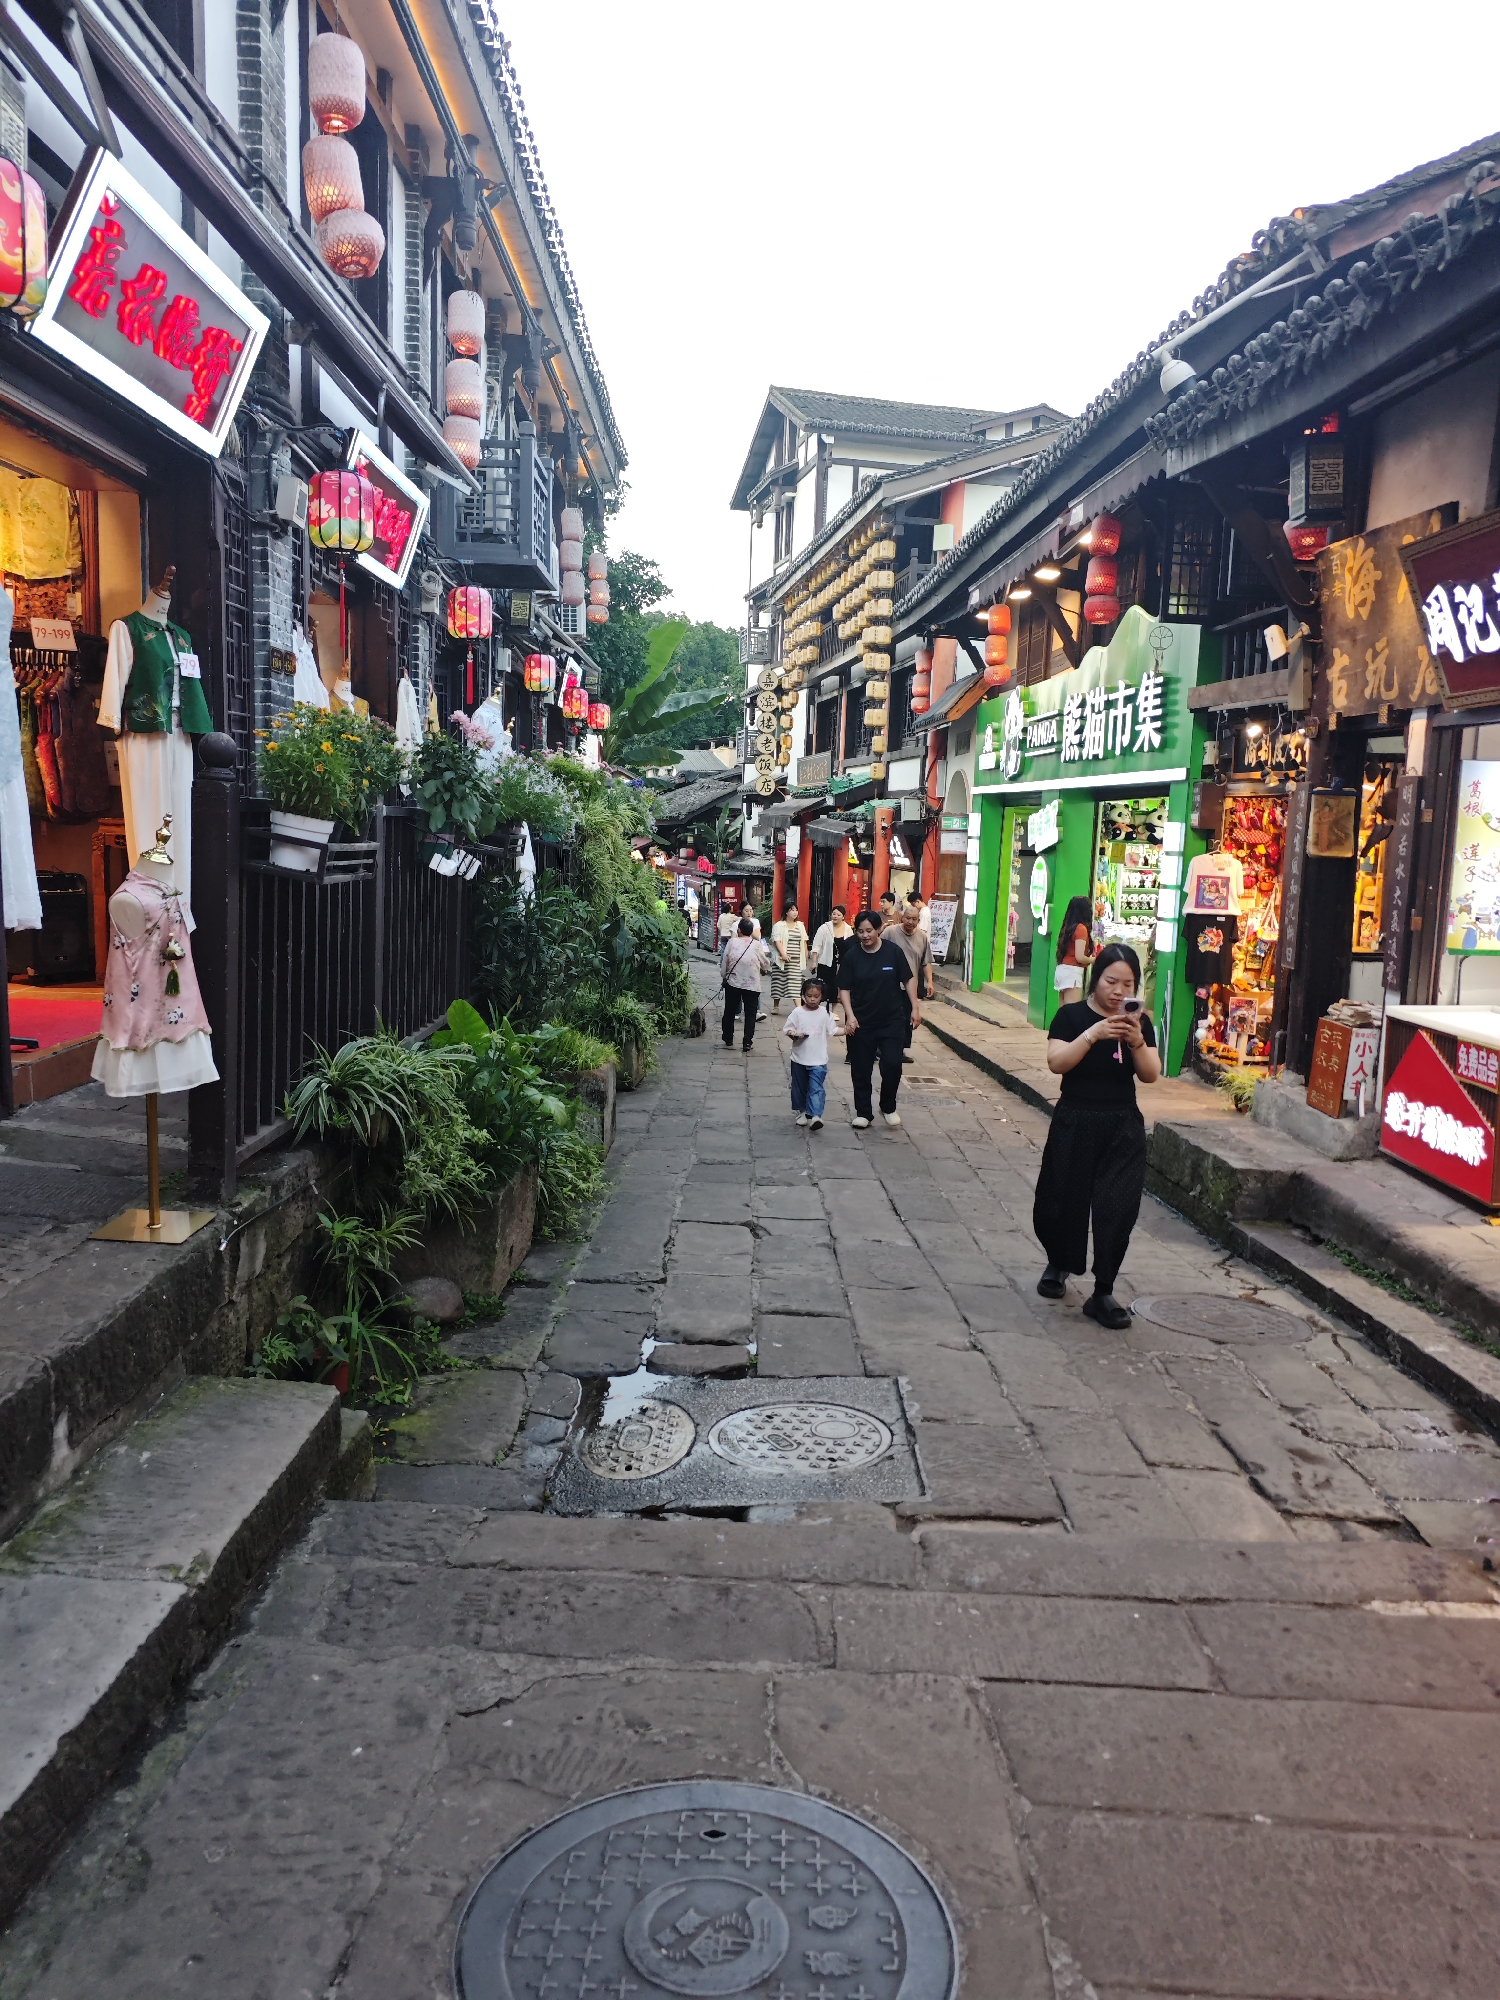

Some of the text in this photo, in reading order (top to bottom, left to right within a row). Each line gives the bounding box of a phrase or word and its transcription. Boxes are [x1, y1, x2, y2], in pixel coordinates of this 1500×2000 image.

[34, 627, 71, 640] 79-199
[1421, 568, 1500, 664] 周记
[182, 657, 197, 671] 79
[759, 672, 776, 794] 嘉滨楼老饭店
[1027, 717, 1058, 749] PANDA
[1060, 671, 1163, 764] 熊猫市集
[1463, 779, 1482, 818] 葛根
[1458, 1043, 1499, 1087] 免费品尝
